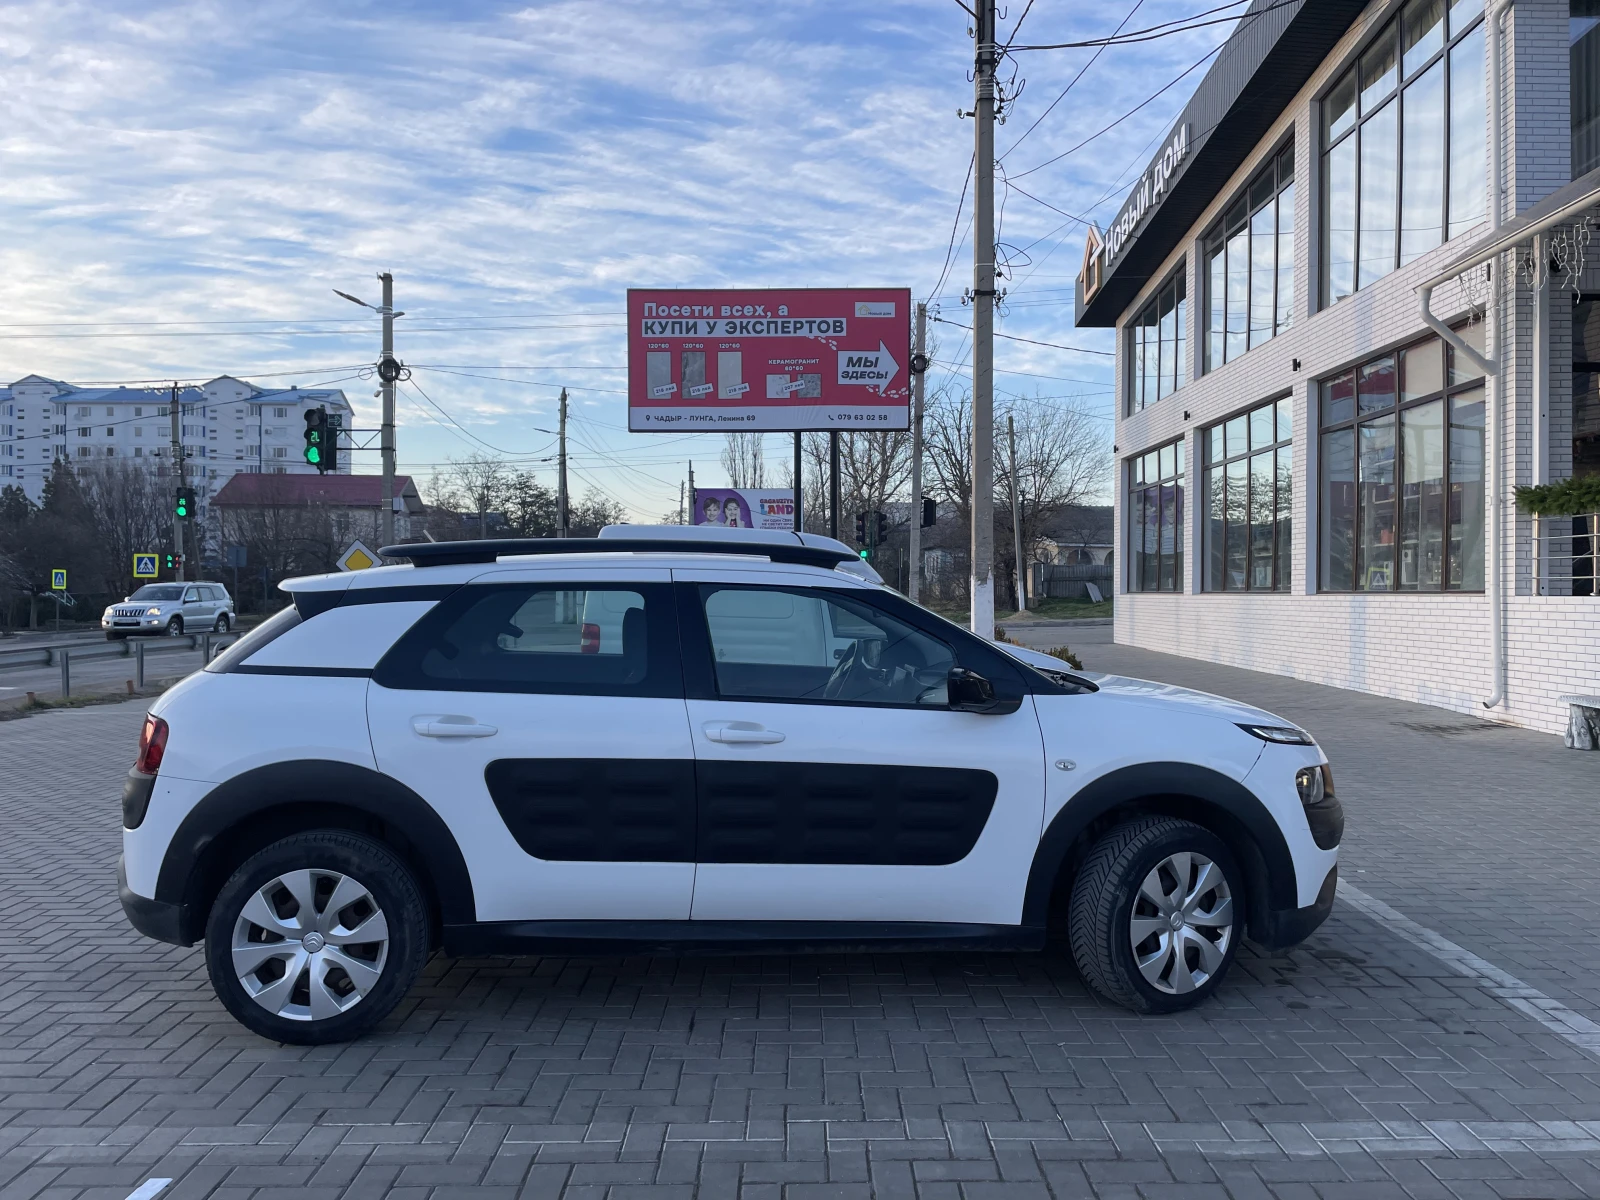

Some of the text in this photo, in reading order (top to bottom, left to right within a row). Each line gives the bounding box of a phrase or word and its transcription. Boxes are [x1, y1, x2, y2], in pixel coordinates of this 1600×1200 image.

[1152, 123, 1188, 205] ДОМ
[644, 302, 789, 319] Посети всех, а
[644, 319, 845, 335] КУПИ У ЭКСПЕРТОВ
[846, 356, 880, 368] МЫ
[841, 370, 889, 381] ЗДЕСЬ!
[654, 415, 683, 423] ЧАДЫР
[837, 413, 852, 421] 079
[760, 504, 794, 515] LAND
